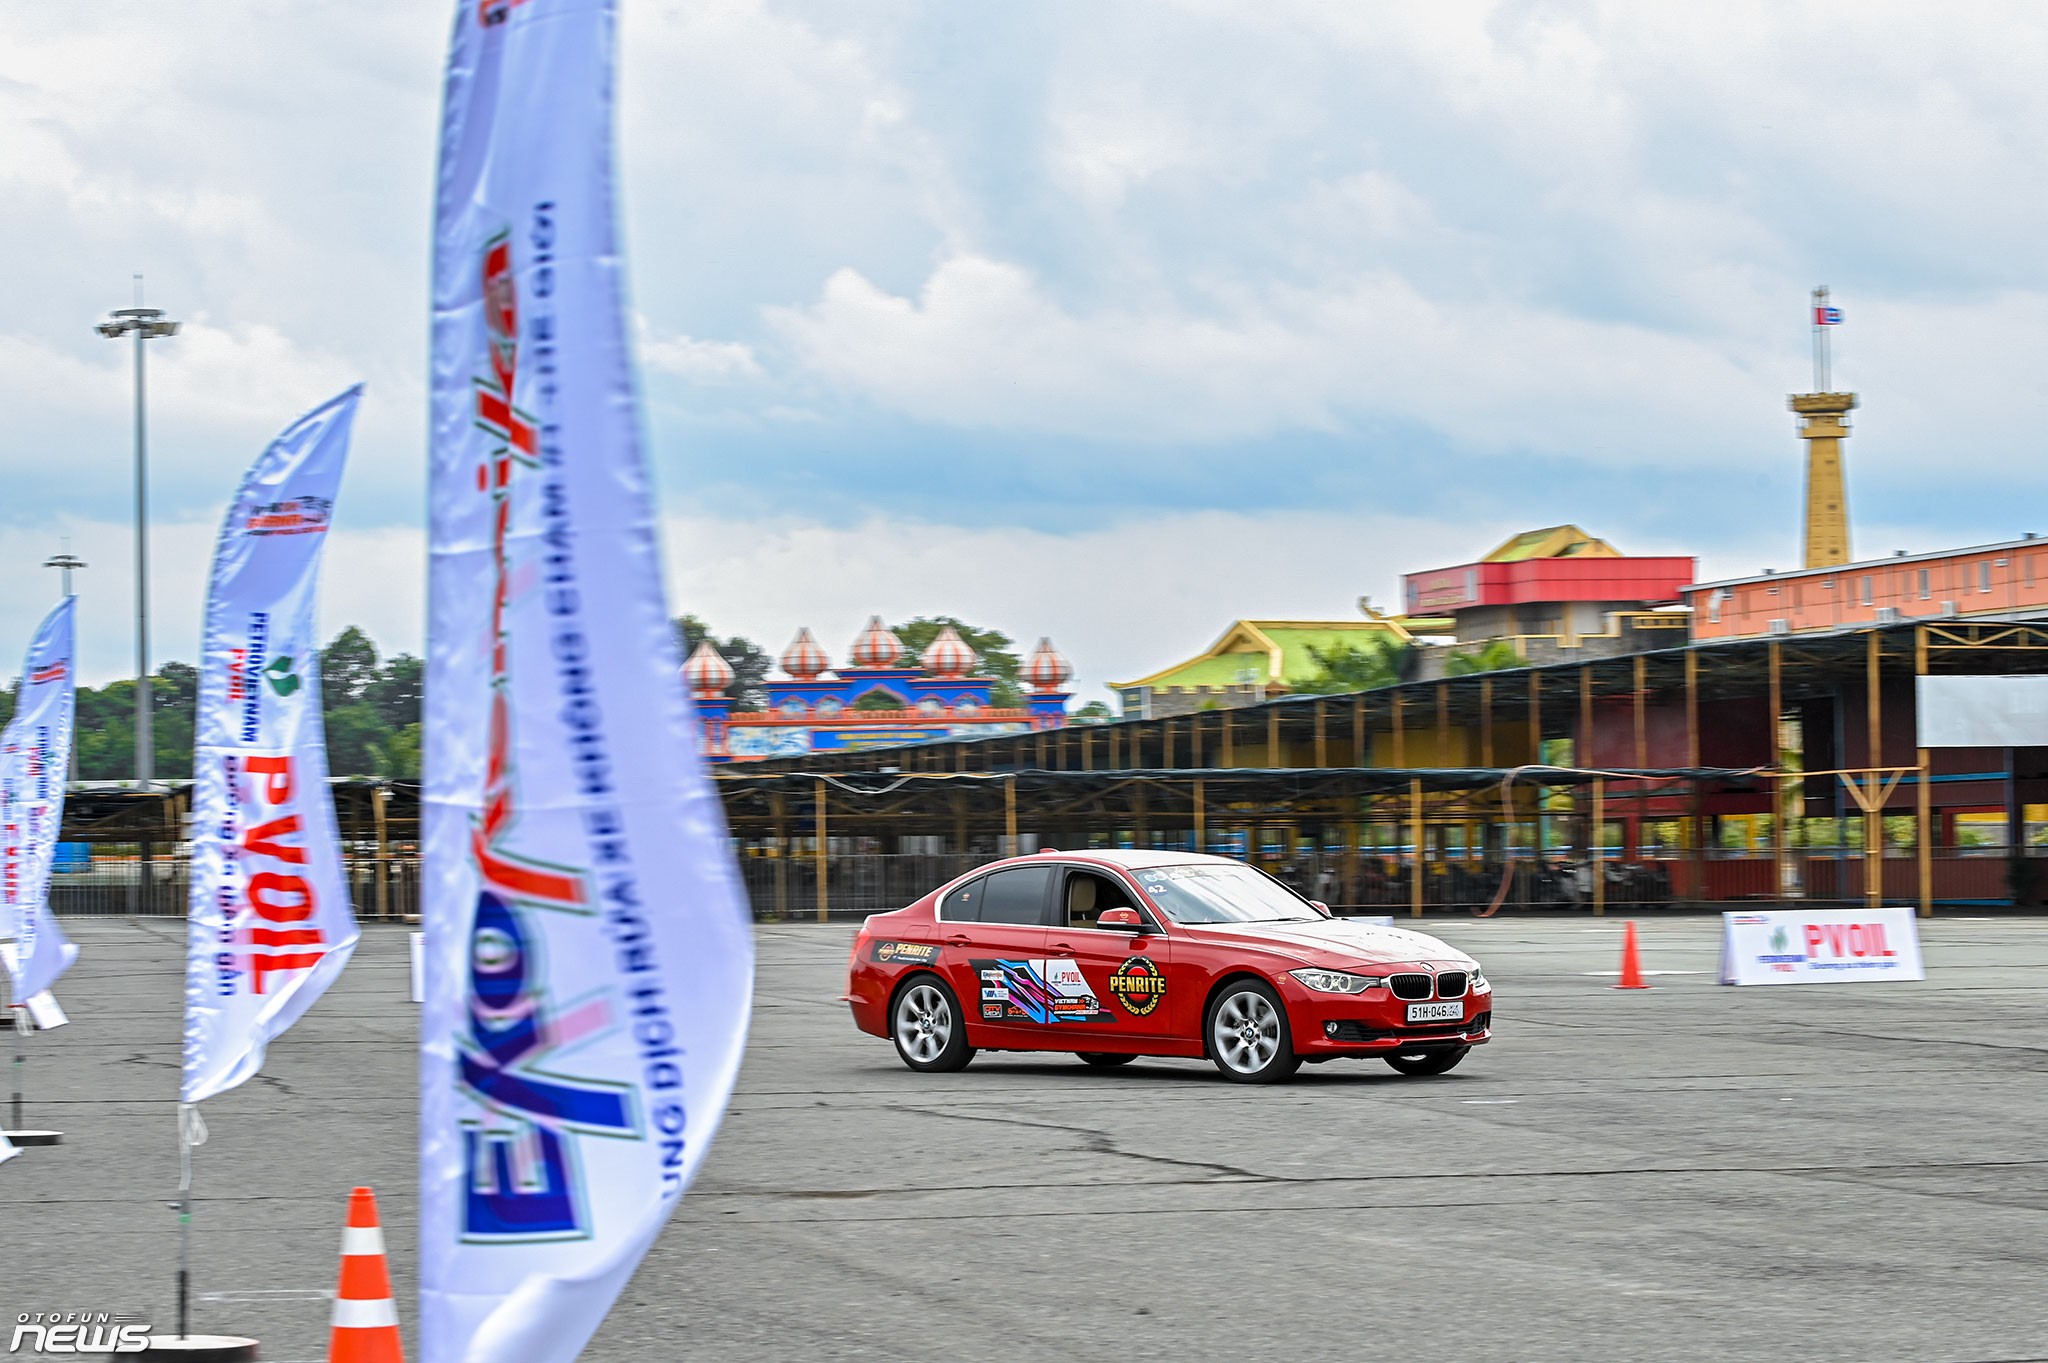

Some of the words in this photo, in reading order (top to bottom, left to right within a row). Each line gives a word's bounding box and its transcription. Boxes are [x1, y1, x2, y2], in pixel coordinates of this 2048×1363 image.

[243, 755, 328, 995] PVOIL
[1803, 923, 1897, 958] PVOIL
[895, 943, 934, 957] PENRITE
[1062, 972, 1081, 983] PVOIL
[1109, 976, 1166, 993] PENRITE
